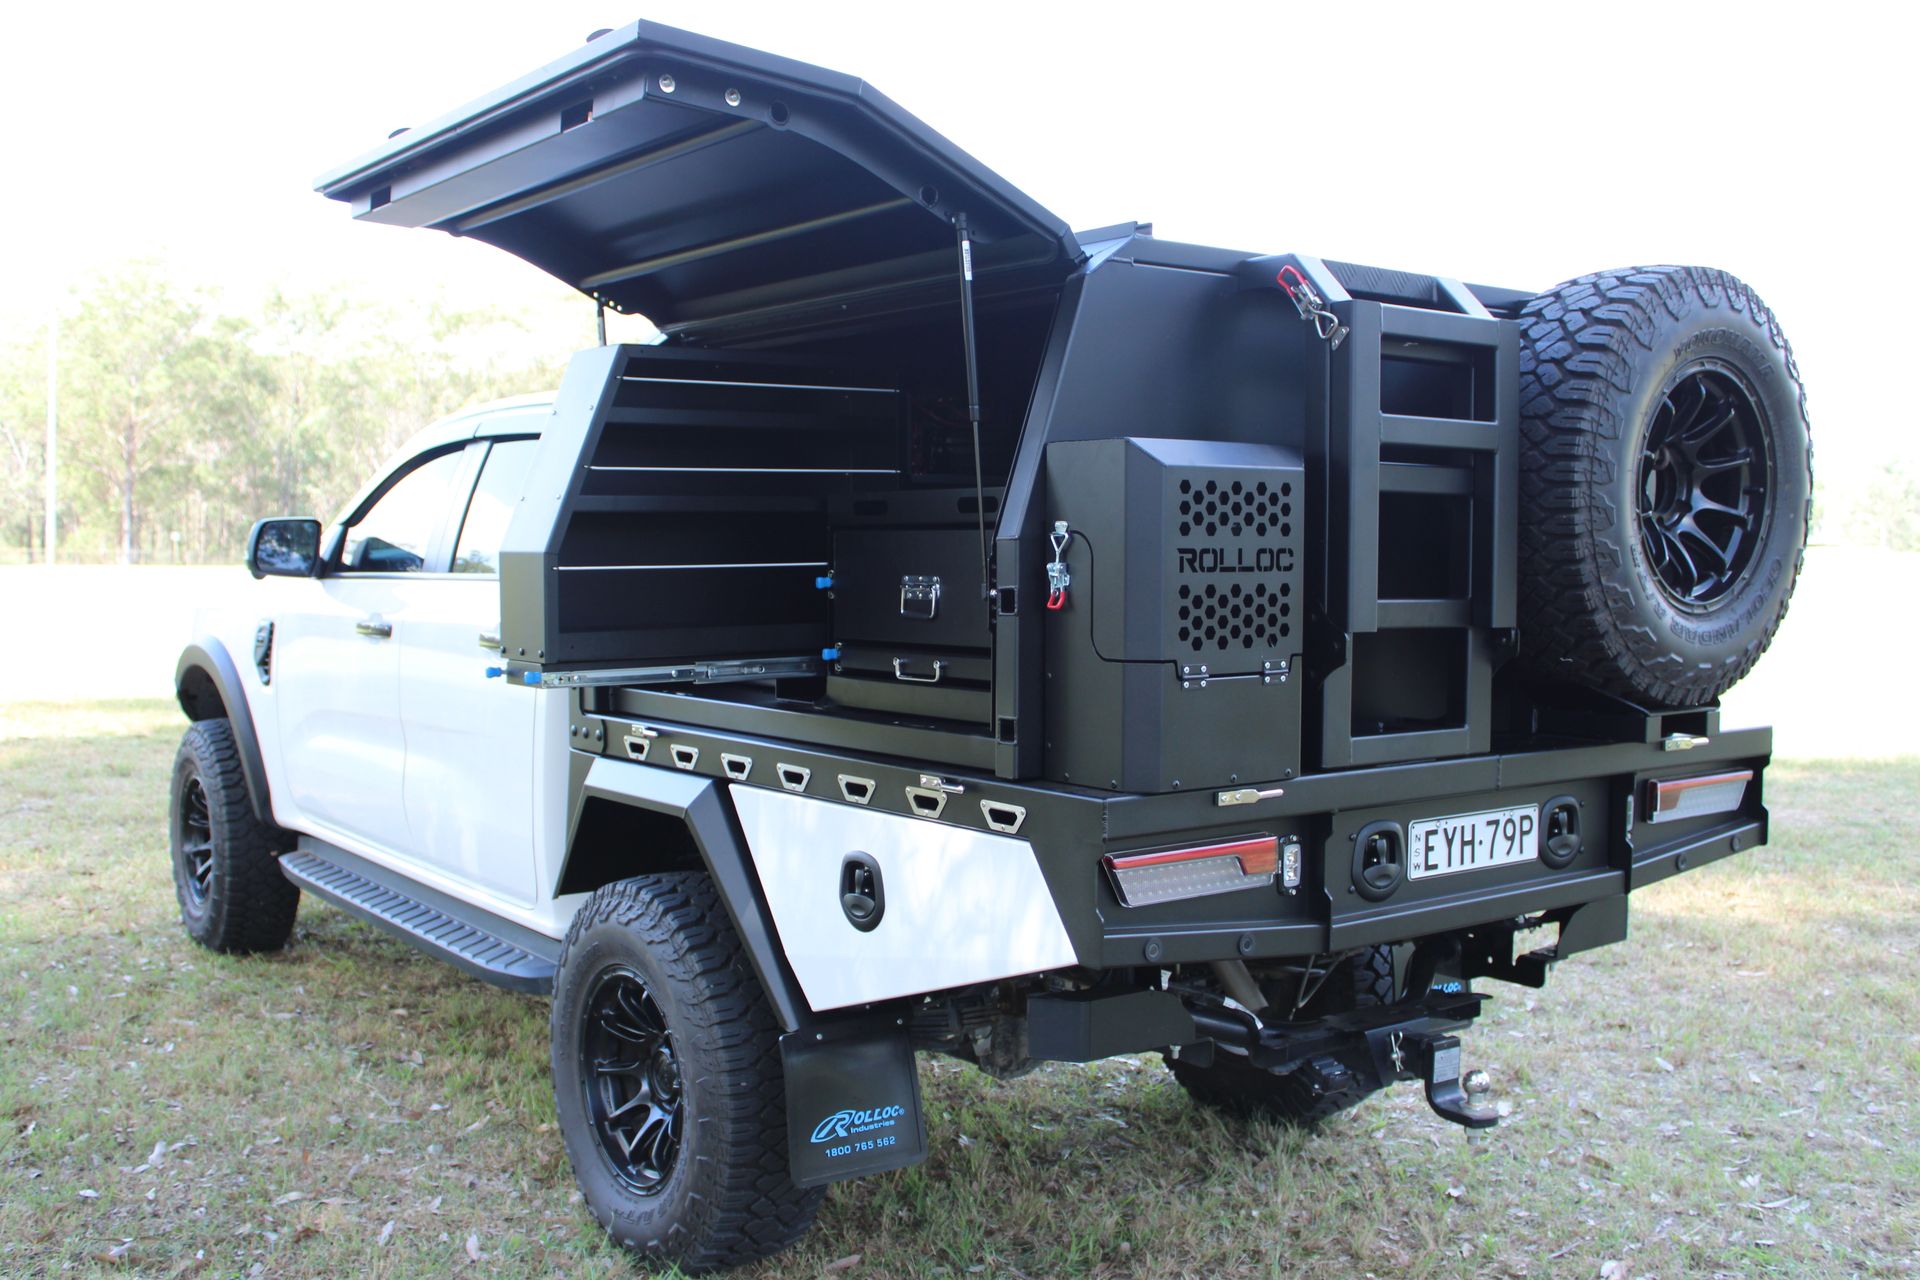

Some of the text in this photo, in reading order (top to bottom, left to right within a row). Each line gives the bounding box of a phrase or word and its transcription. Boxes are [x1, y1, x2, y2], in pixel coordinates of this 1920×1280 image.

[1177, 548, 1294, 573] ROLLOC
[850, 1119, 895, 1134] Industries
[825, 1136, 896, 1158] 1800 765 562
